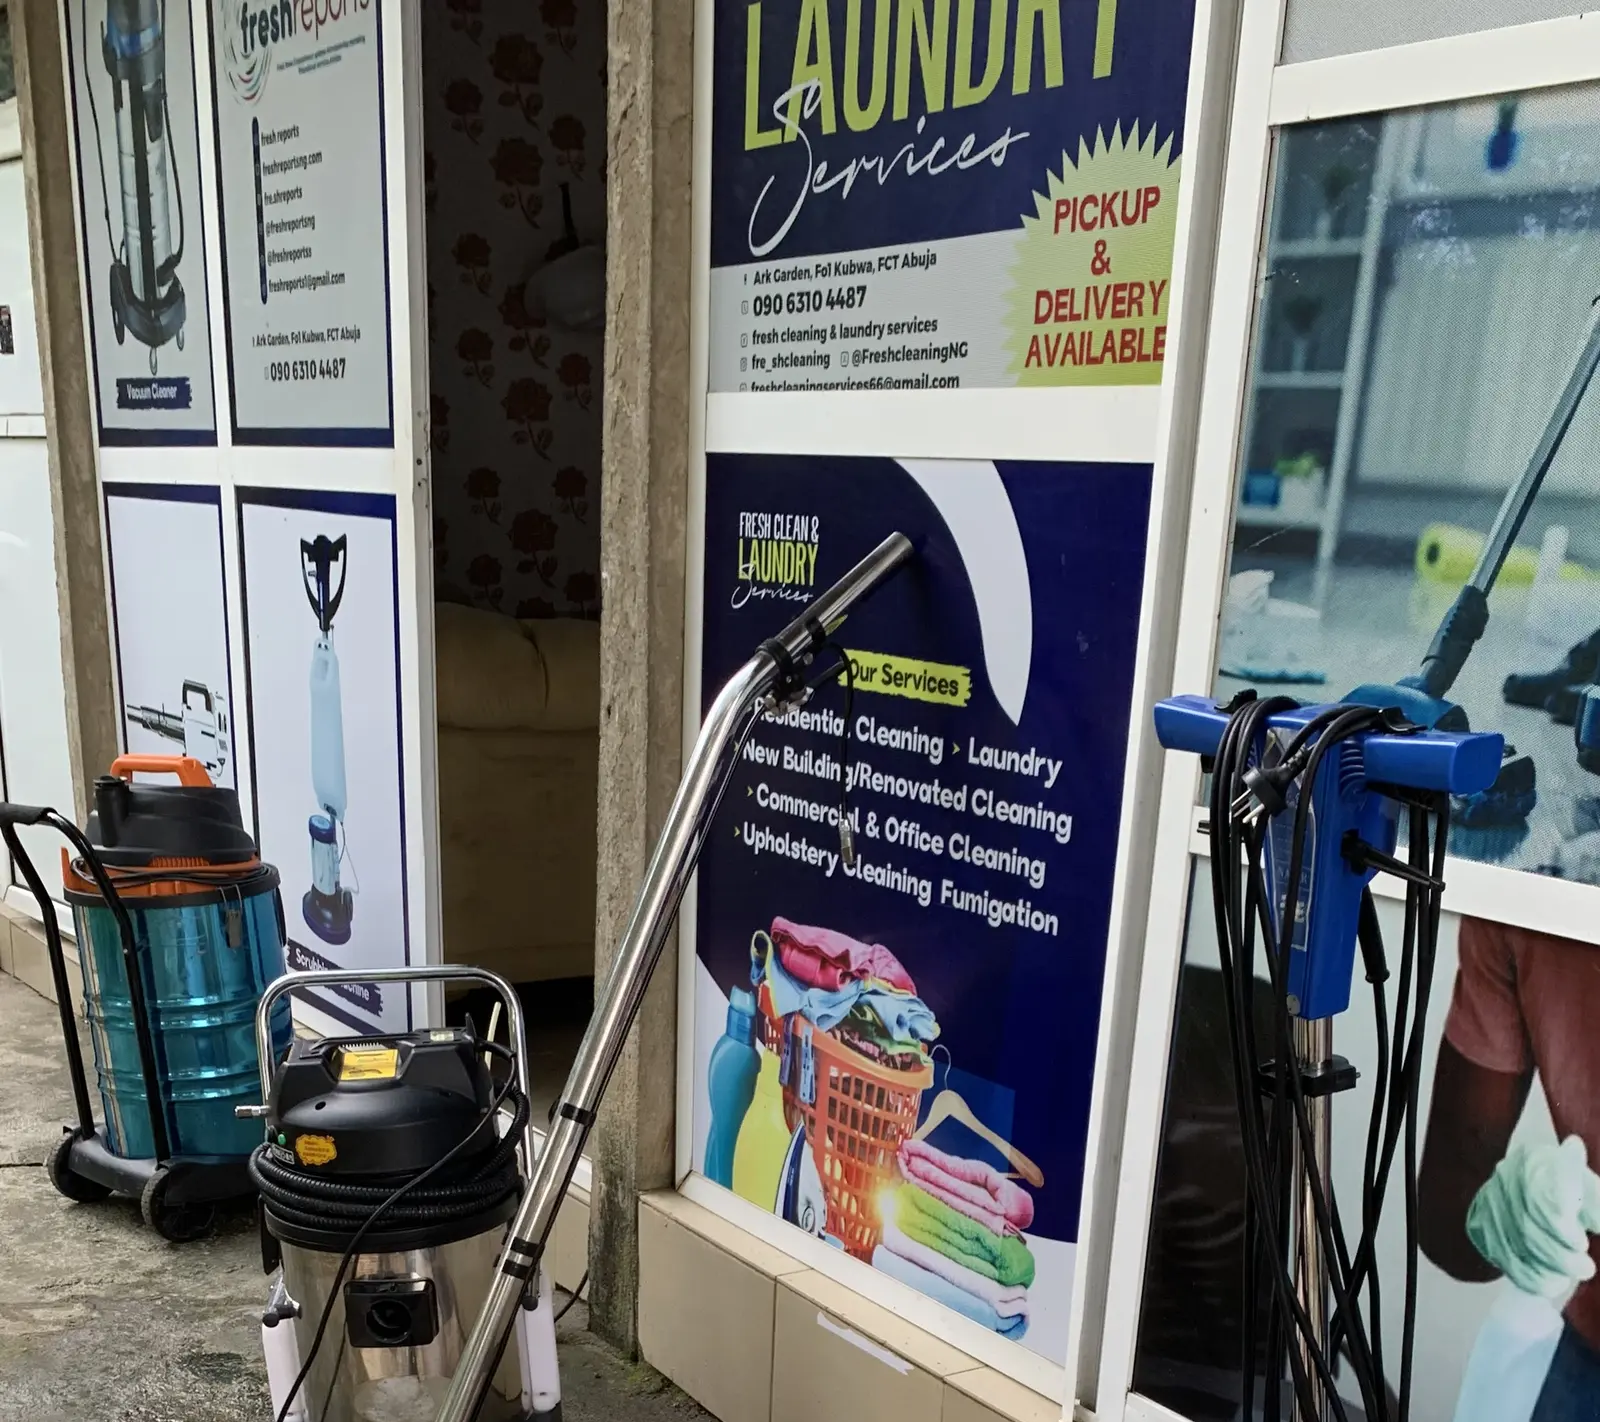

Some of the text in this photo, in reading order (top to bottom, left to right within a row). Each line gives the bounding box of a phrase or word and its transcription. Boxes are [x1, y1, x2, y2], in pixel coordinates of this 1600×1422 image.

[240, 0, 370, 53] freshrepo
[260, 124, 300, 147] fresh reports
[262, 150, 323, 176] freshreportsng.com
[748, 77, 1030, 257] Services
[265, 214, 316, 237] @freshreportsng
[1053, 185, 1161, 235] PICKUP
[753, 271, 772, 286] Ark
[773, 266, 813, 283] Garden,
[834, 258, 876, 277] Kubwa,
[877, 255, 900, 272] FCT
[901, 248, 937, 270] Abuja
[1090, 239, 1112, 276] &
[753, 285, 867, 316] 090 6310 4487
[1033, 278, 1168, 325] DELIVERY
[256, 333, 267, 347] Ark
[301, 329, 326, 343] Kubwa,
[326, 327, 339, 342] FCT
[340, 324, 361, 343] Abuja
[752, 316, 938, 345] fresh cleaning & laundry services
[1024, 325, 1167, 369] AVAILABLE
[270, 357, 346, 382] 090 6310 4487
[752, 341, 968, 372] fre_shcleaning @FreshcleaningNG
[126, 382, 178, 400] Vacuum Cleaner
[739, 511, 820, 543] FRESH CLEAN &
[738, 538, 819, 586] LAUNDRY
[730, 563, 814, 609] Services
[850, 658, 959, 697] Our Services
[855, 715, 944, 765] Cleaning
[968, 736, 1063, 789] Laundry
[742, 738, 780, 767] New
[971, 788, 1073, 844] Cleaning
[865, 811, 880, 839] &
[885, 816, 944, 855] Office
[948, 832, 1046, 889] Cleaning
[743, 821, 839, 877] Upholstery
[940, 878, 1059, 936] Fumigation
[295, 947, 329, 971] Scrubbi
